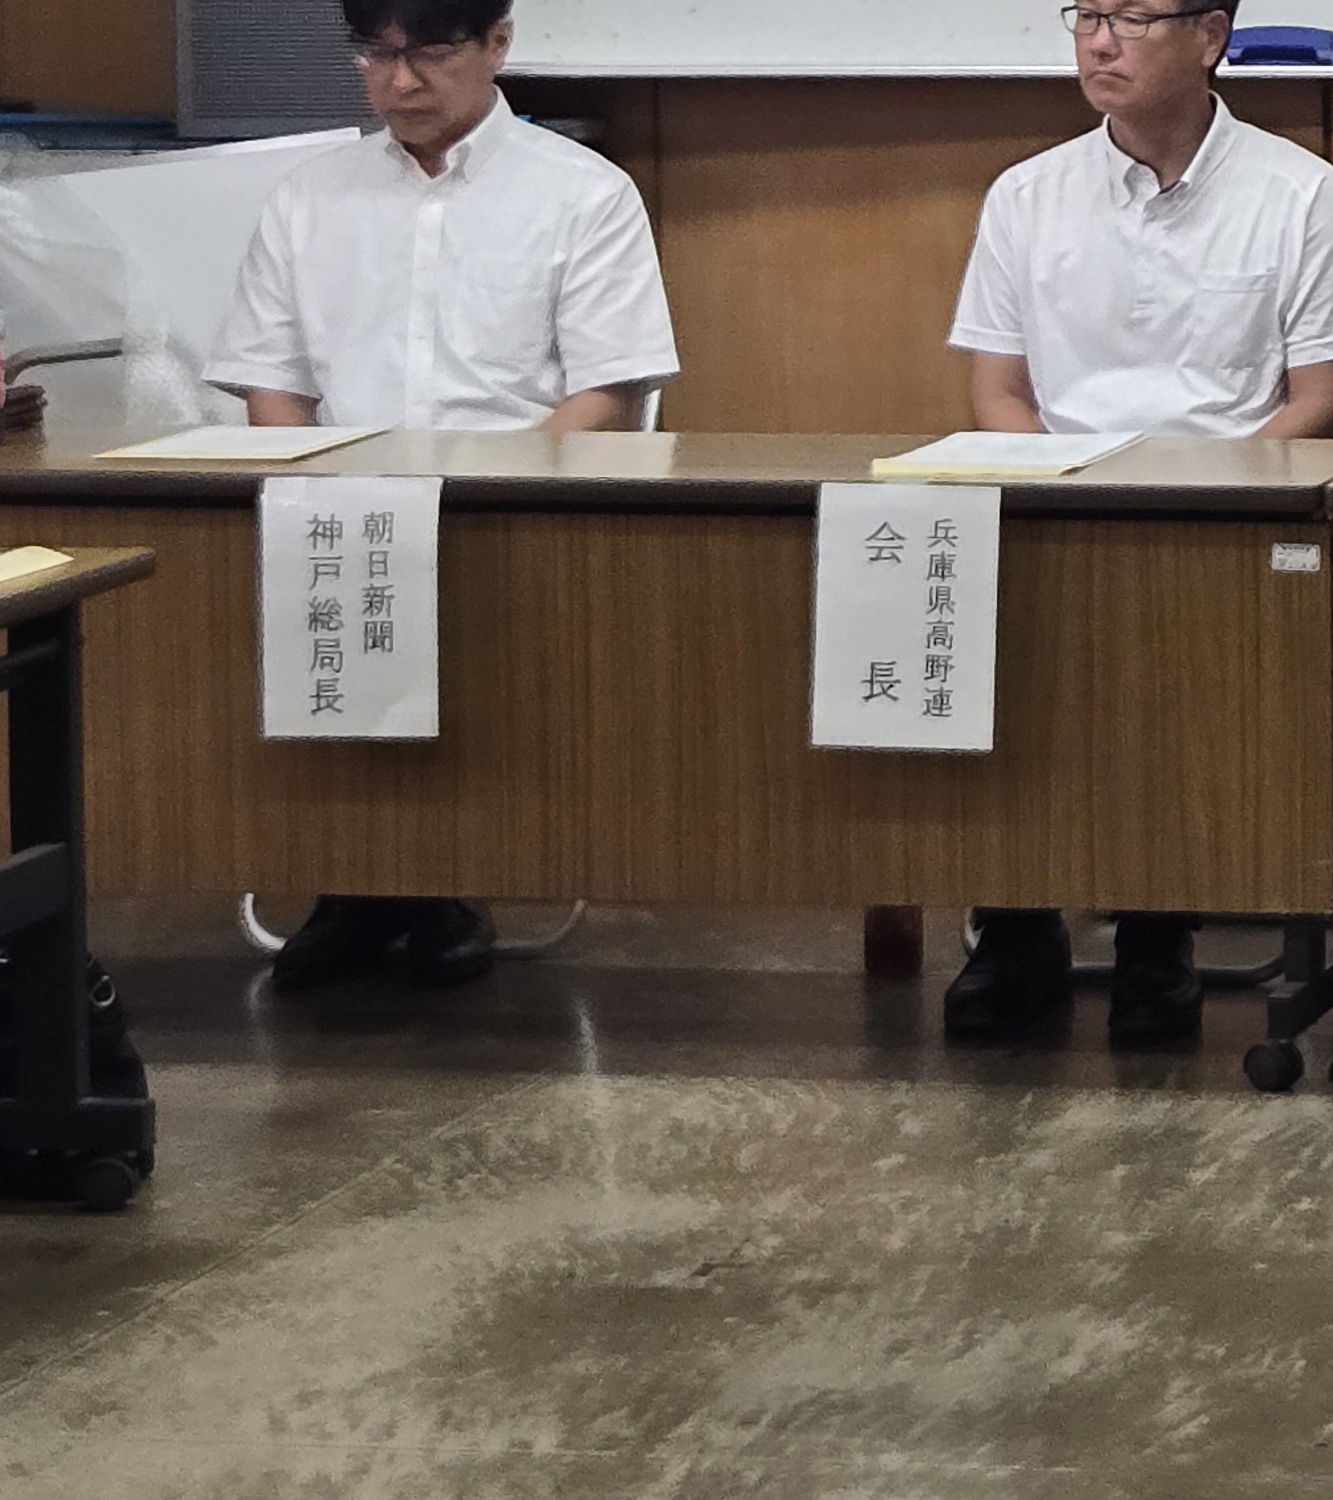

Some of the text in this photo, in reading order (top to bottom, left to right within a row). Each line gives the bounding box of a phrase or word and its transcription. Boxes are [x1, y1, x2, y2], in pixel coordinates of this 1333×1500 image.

[306, 513, 345, 716] 神戸総局長
[362, 511, 395, 655] 朝日新聞
[861, 521, 906, 703] 会長
[922, 518, 959, 718] 兵庫県高野連
